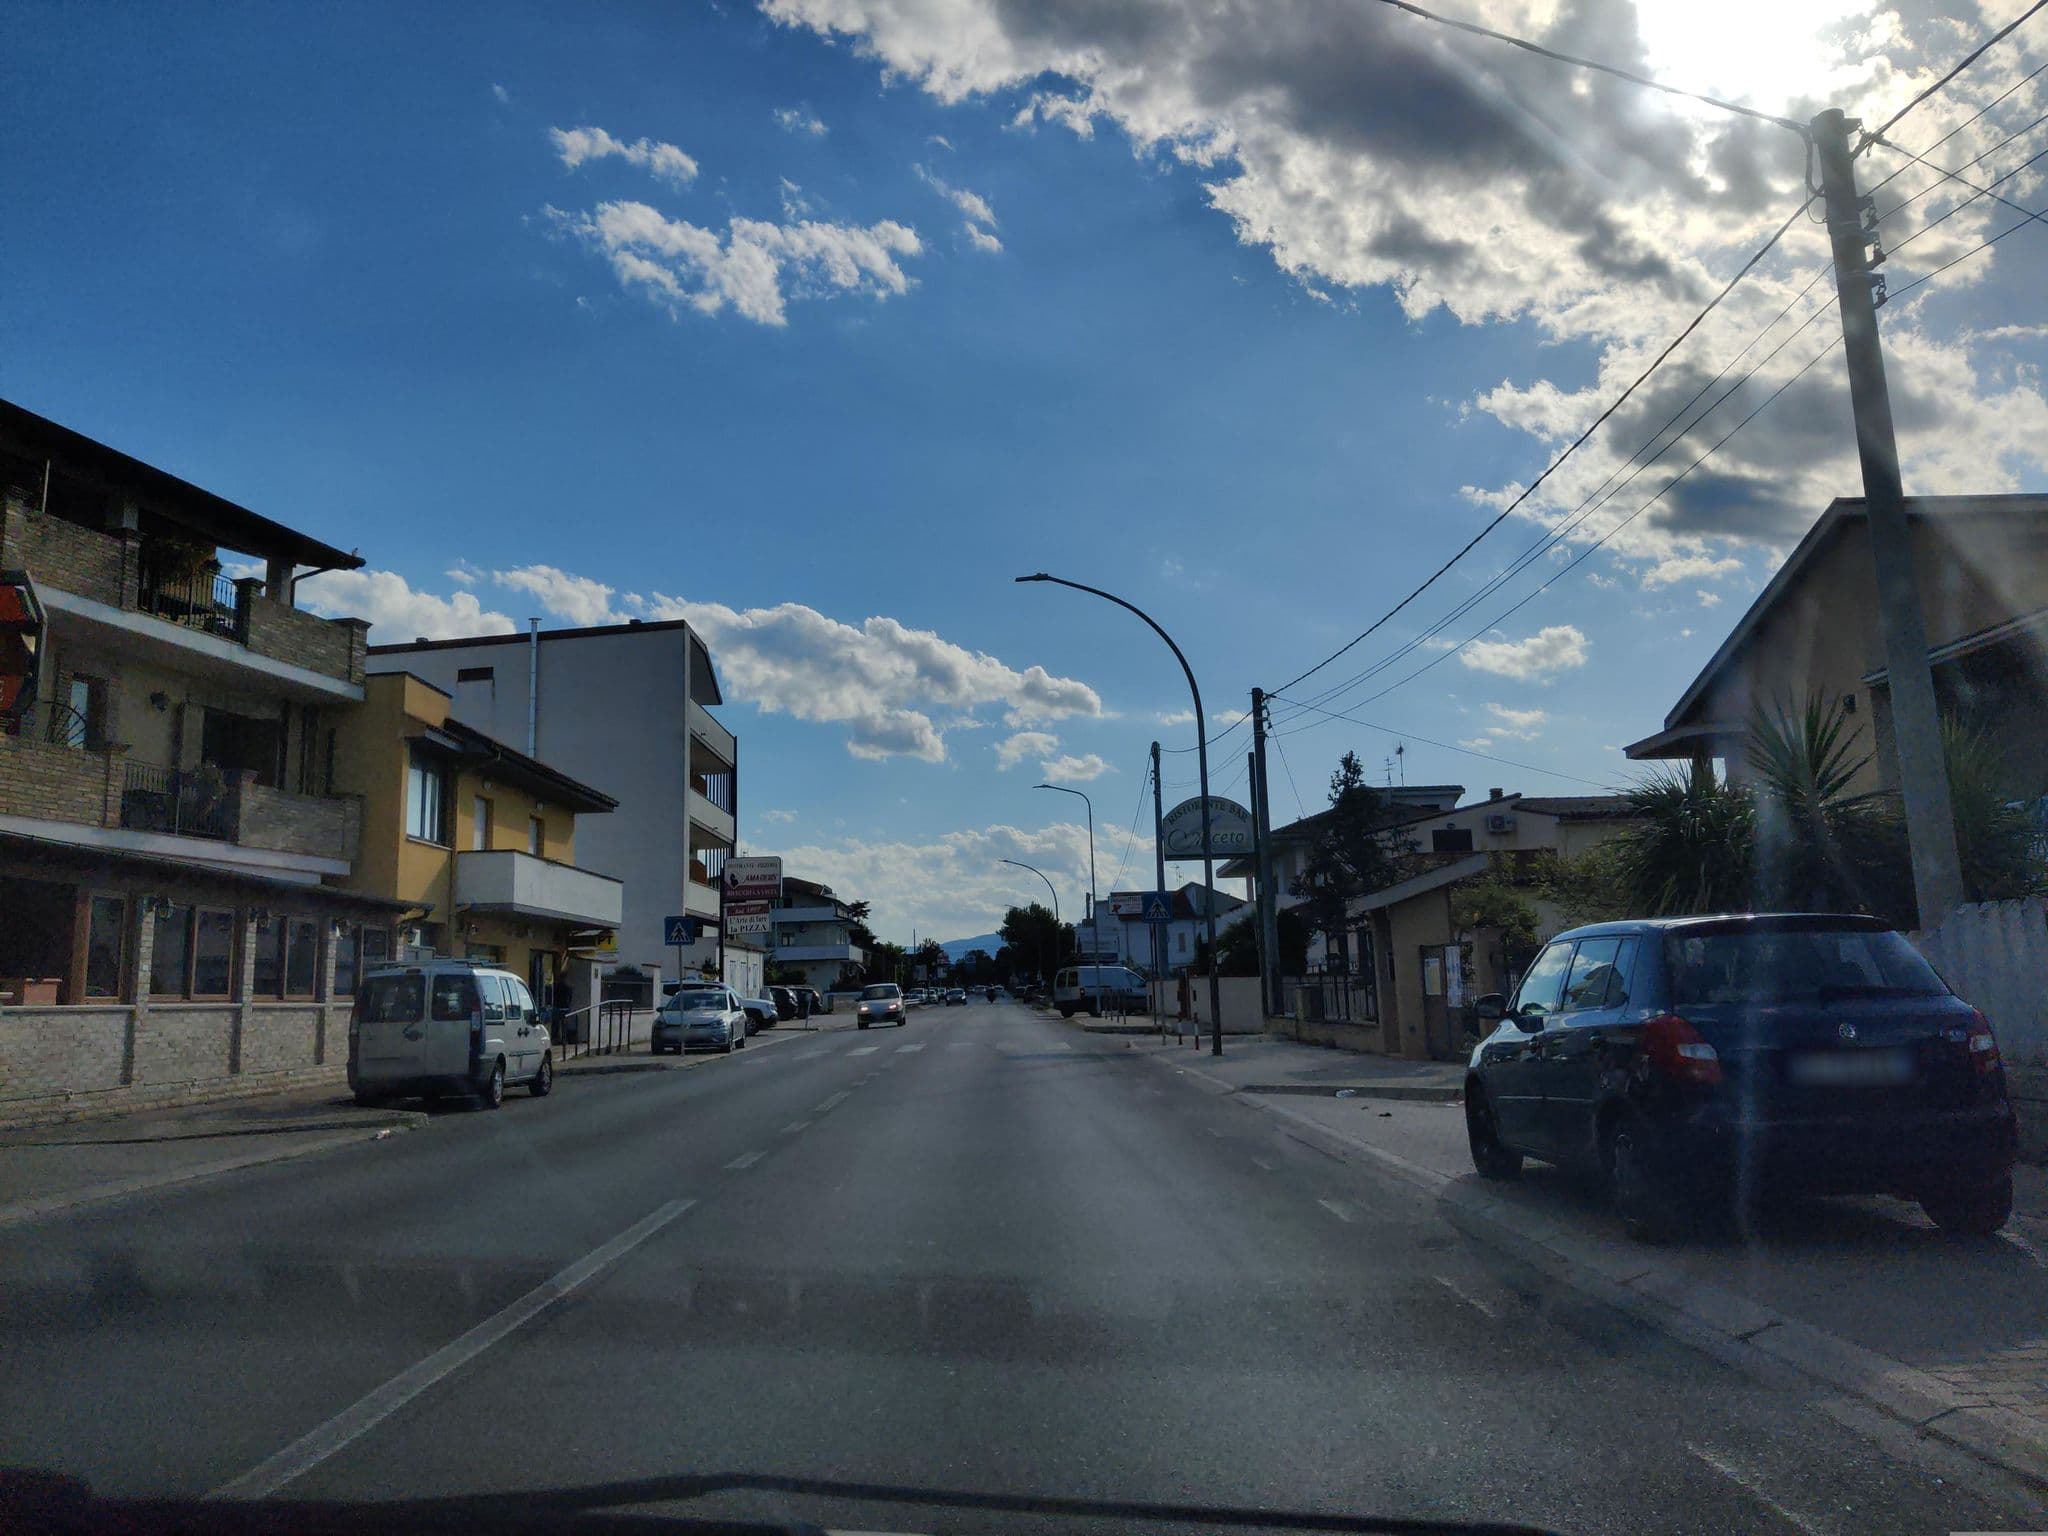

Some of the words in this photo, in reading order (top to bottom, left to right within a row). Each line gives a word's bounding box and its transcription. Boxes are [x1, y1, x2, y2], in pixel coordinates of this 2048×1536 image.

[1167, 799, 1226, 825] RISTORNTE
[1228, 803, 1248, 824] BAR
[740, 924, 767, 932] PIZZA
